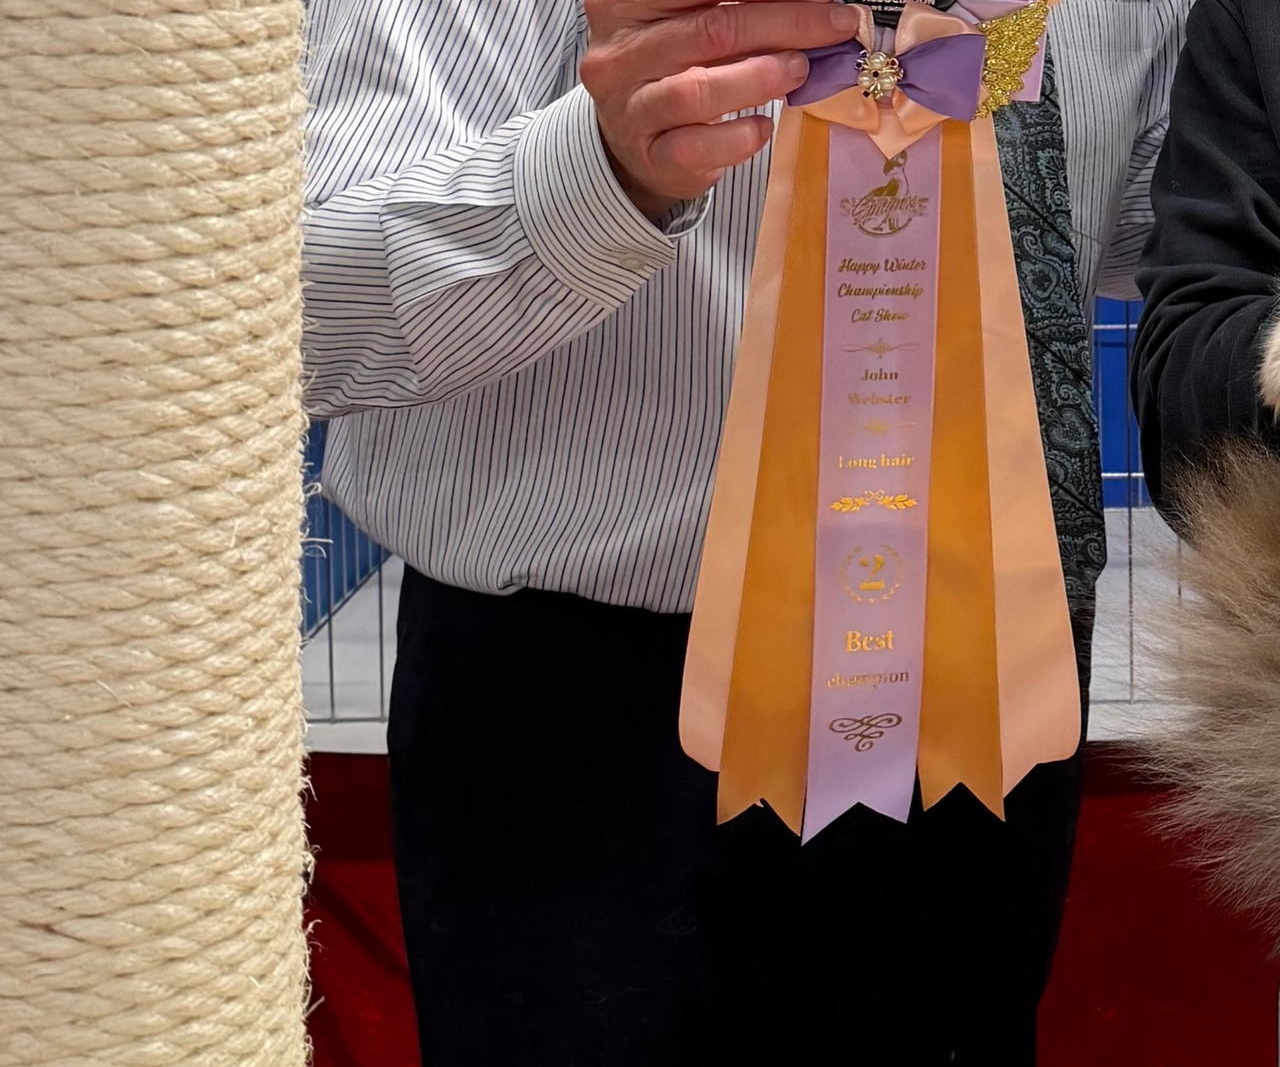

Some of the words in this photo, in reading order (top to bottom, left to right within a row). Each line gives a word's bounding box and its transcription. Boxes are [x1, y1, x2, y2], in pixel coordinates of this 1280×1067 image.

[838, 258, 881, 275] Happy
[884, 257, 927, 273] Winter
[838, 283, 924, 299] Championship
[851, 308, 874, 323] Cat
[874, 308, 908, 323] Show
[861, 368, 899, 381] John
[858, 554, 885, 591] 2
[846, 630, 894, 652] Best
[826, 670, 909, 689] champion
